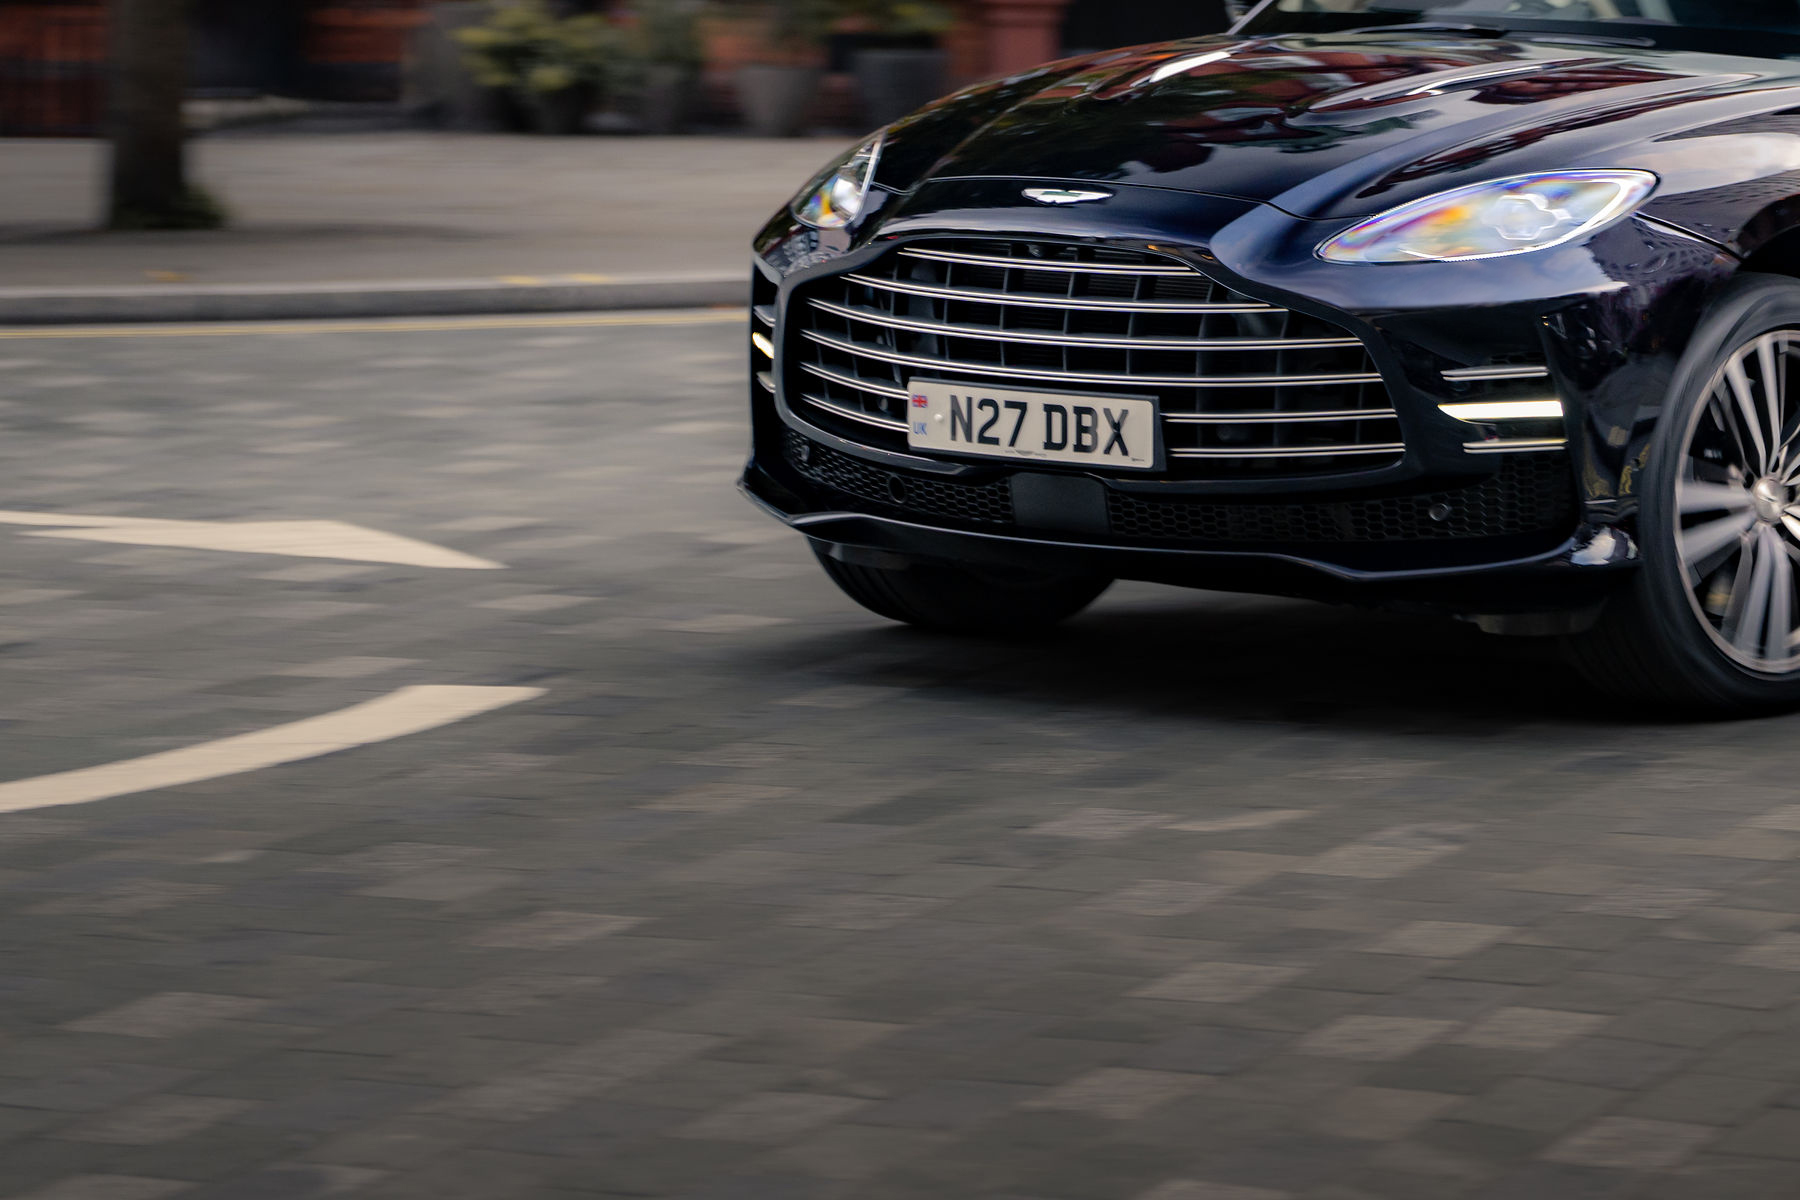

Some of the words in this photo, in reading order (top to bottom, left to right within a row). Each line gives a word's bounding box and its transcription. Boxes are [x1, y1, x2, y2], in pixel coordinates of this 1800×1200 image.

[912, 421, 928, 436] UK
[949, 394, 1028, 448] N27
[1043, 403, 1129, 457] DBX
